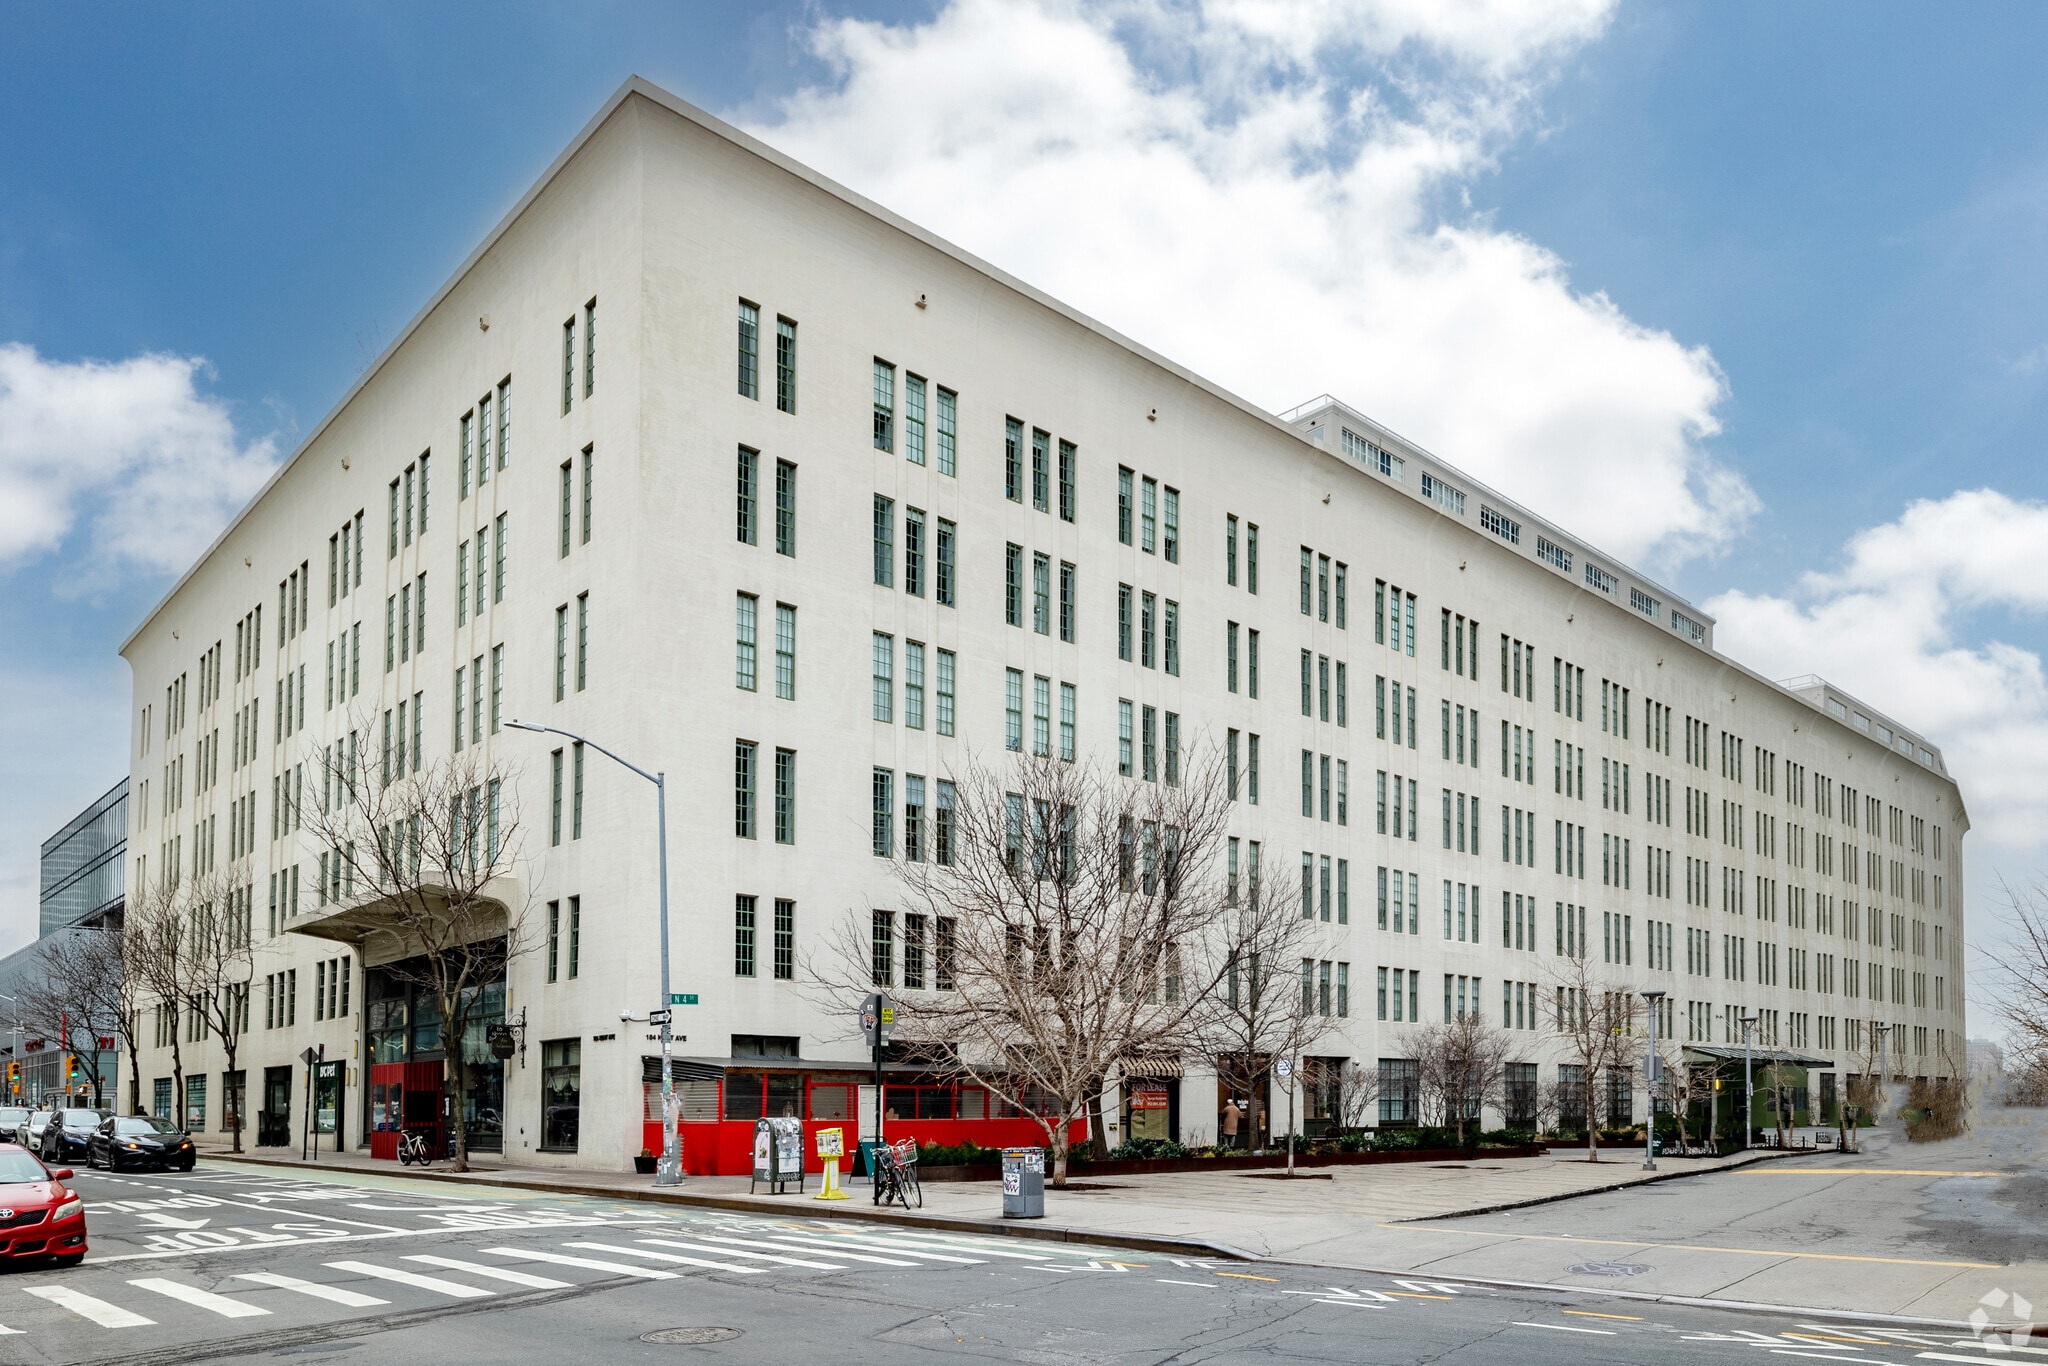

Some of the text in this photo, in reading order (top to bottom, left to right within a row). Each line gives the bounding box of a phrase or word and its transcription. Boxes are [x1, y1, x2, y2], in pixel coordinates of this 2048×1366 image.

[674, 994, 680, 1004] N
[682, 994, 687, 1004] 4
[1131, 1083, 1168, 1092] FOR LEASE
[143, 1222, 351, 1252] STOP
